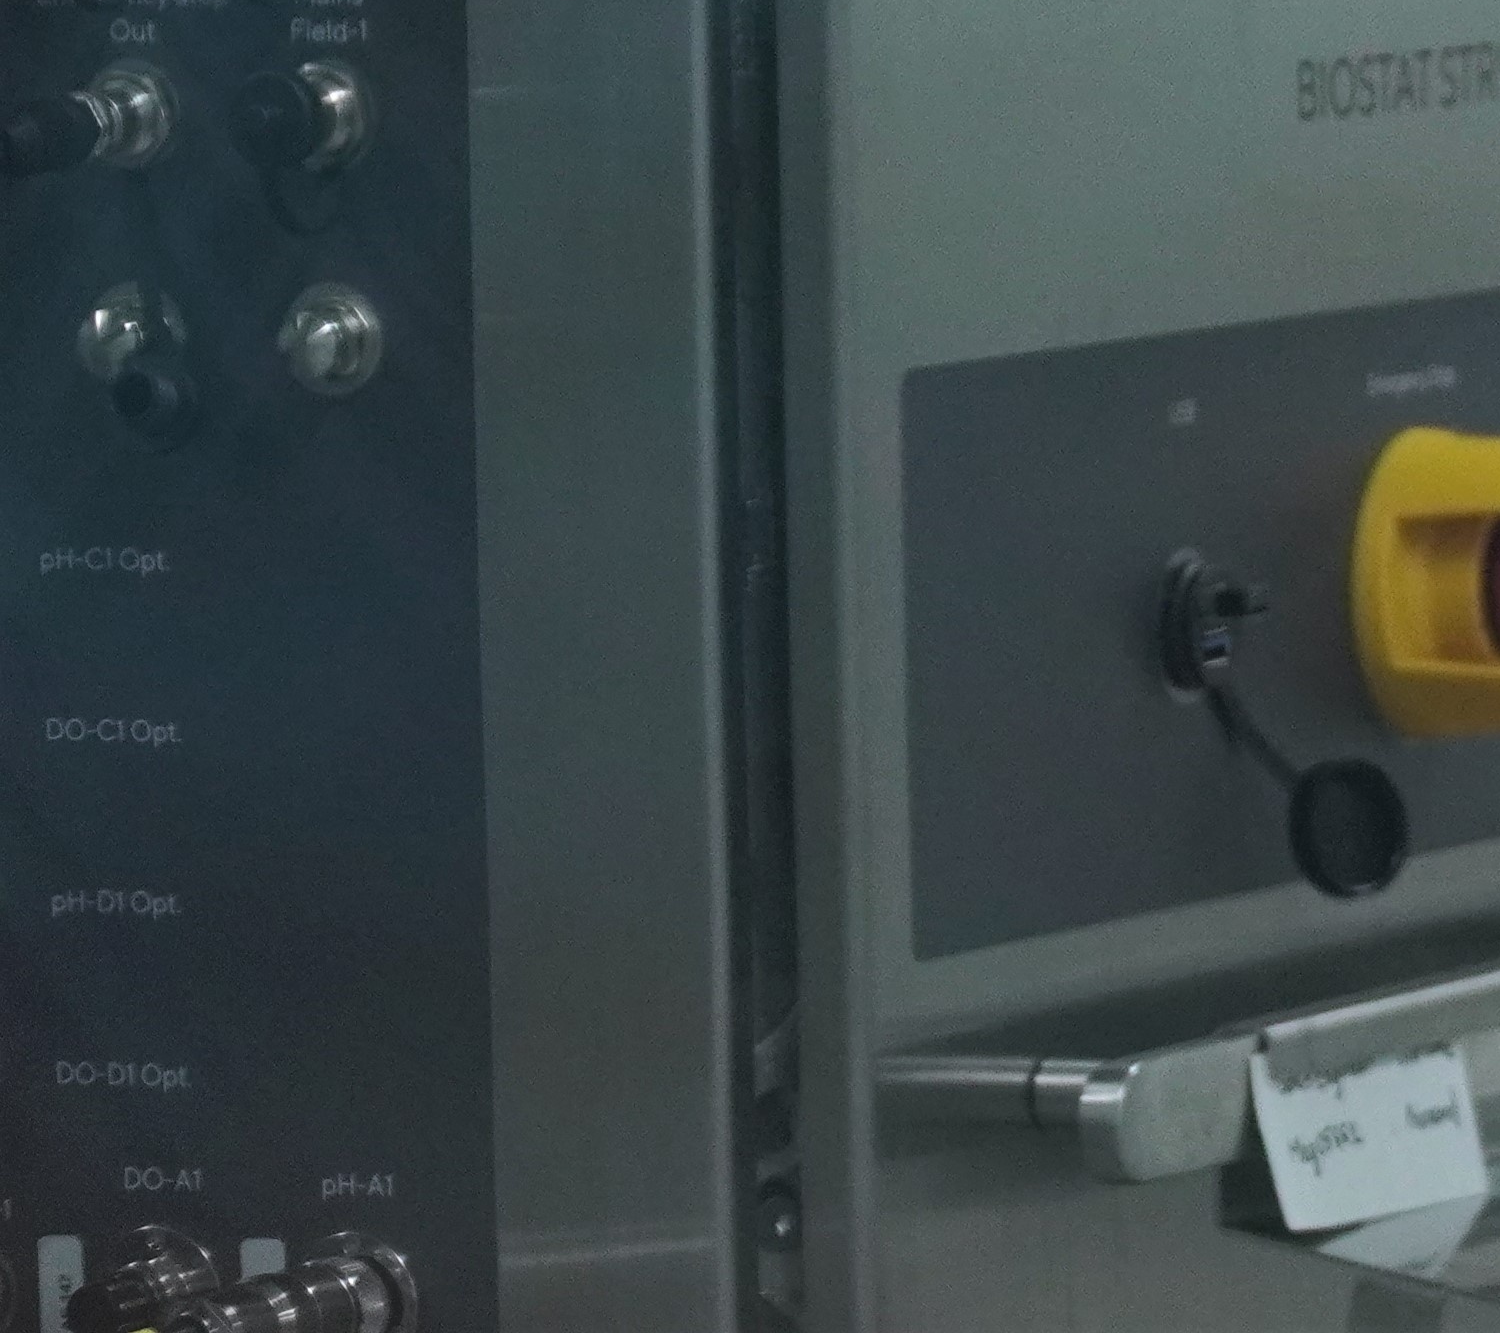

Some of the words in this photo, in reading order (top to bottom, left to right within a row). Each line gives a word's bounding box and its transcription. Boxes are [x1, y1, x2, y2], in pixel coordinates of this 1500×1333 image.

[1296, 47, 1434, 122] BIOSTAT
[123, 1166, 201, 1192] DO-A1
[321, 1172, 395, 1201] pH-A1
